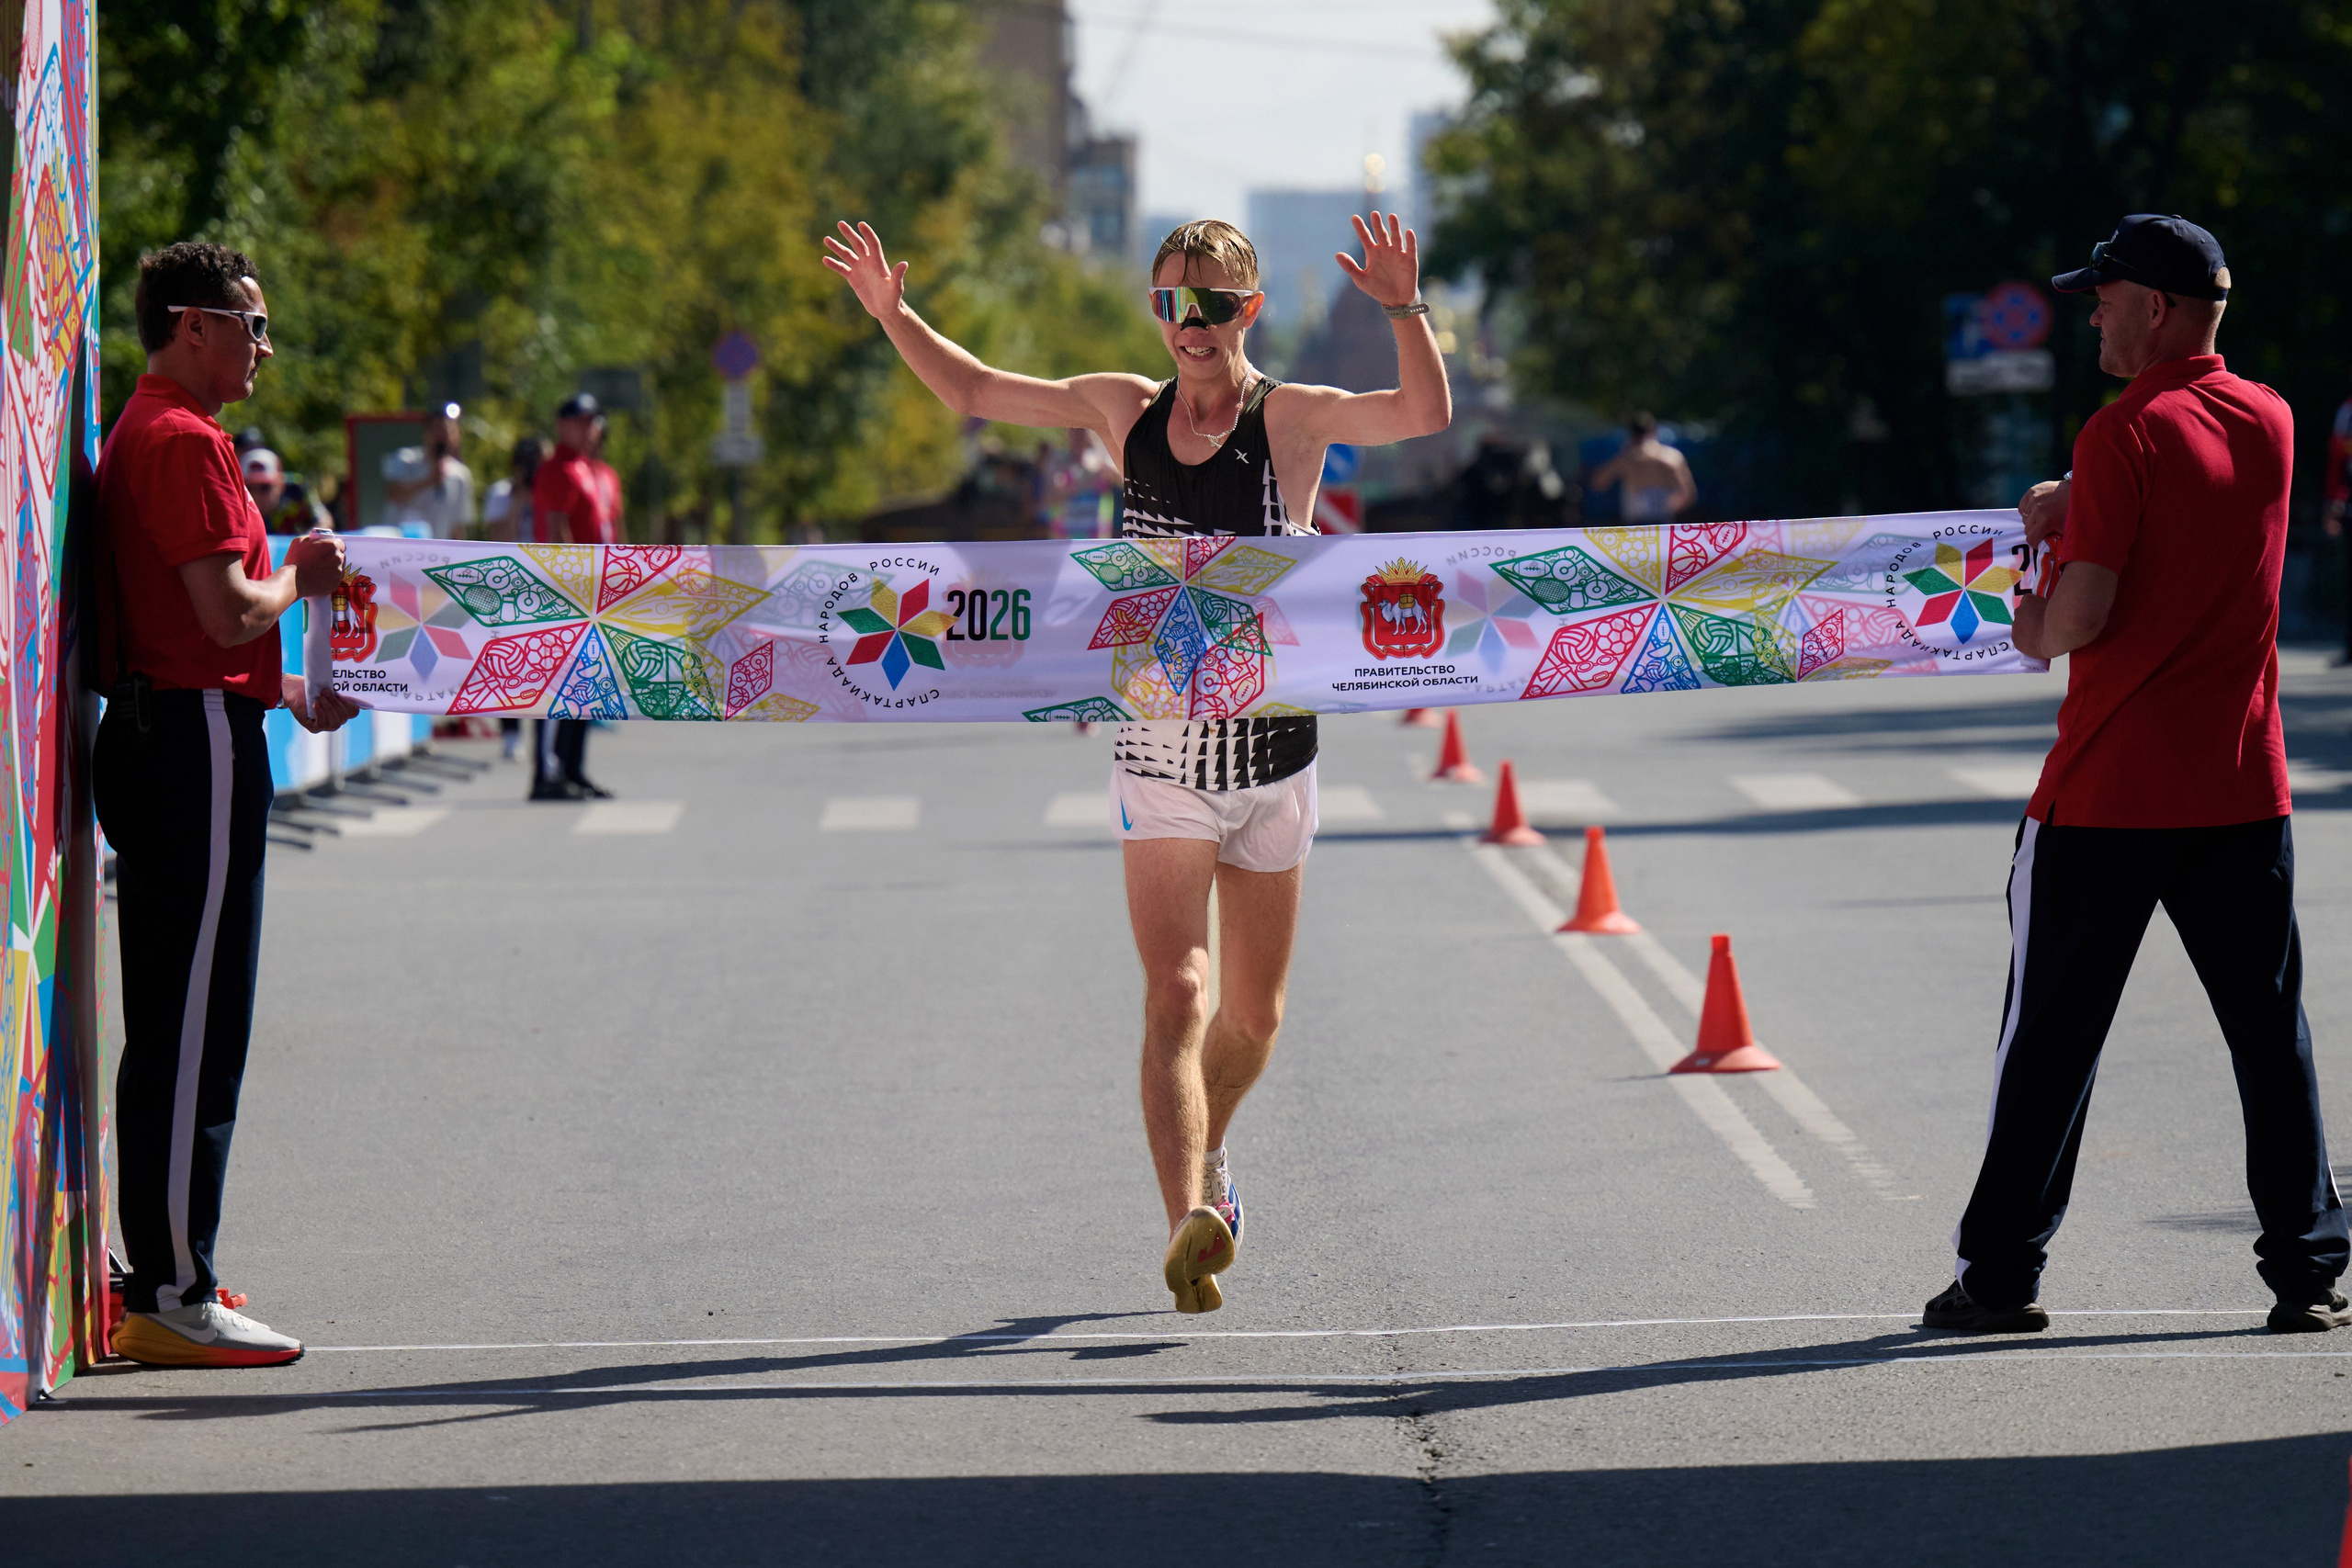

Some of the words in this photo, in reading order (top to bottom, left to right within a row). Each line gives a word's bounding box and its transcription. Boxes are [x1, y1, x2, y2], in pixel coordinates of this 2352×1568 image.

[1932, 525, 2004, 540] РОССИИ
[869, 557, 940, 577] РОССИИ
[1885, 541, 1922, 608] НАРОДОВ
[819, 572, 858, 644] НАРОДОВ
[945, 589, 1032, 641] 2026
[1895, 621, 2009, 660] СПАРТАКИАДА
[333, 669, 387, 679] ЕЛЬСТВО
[1354, 664, 1455, 678] ПРАВИТЕЛЬСТВО
[353, 682, 409, 692] ОБЛАСТИ
[826, 656, 940, 709] СПАРТАКИАДА
[1331, 677, 1419, 692] ЧЕЛЯБИНСКОЙ
[1424, 675, 1478, 686] ОБЛАСТИ
